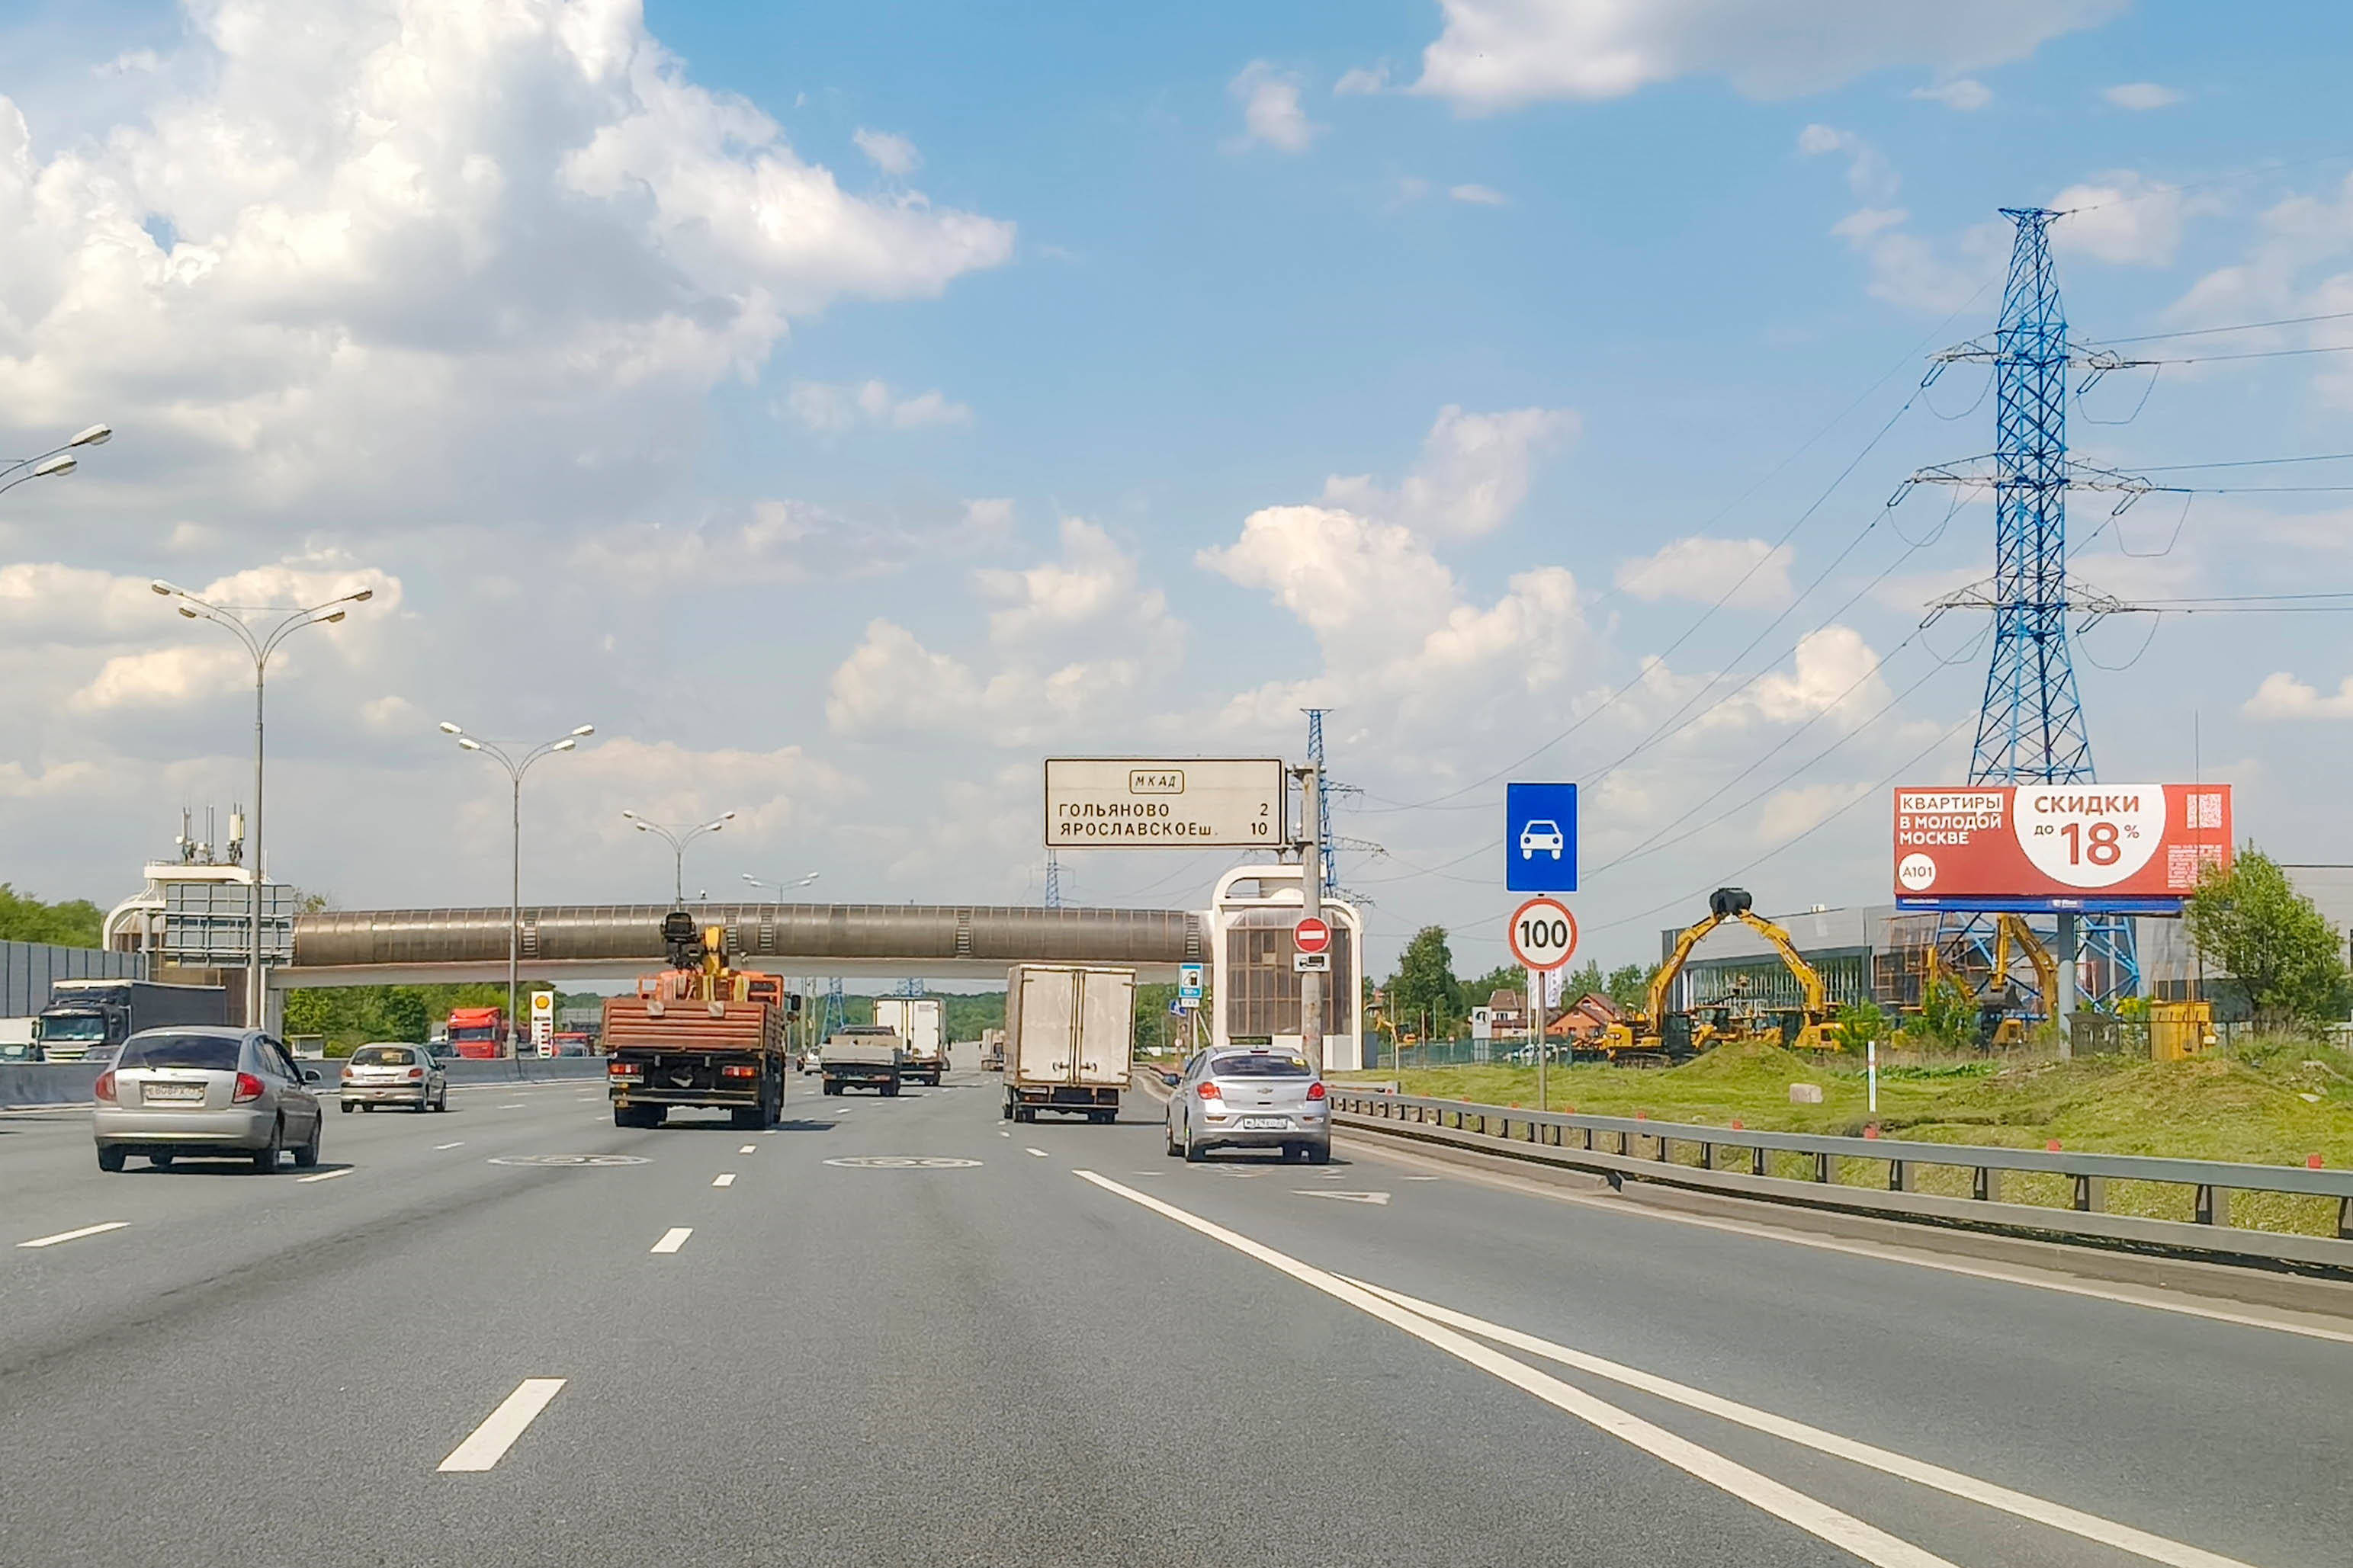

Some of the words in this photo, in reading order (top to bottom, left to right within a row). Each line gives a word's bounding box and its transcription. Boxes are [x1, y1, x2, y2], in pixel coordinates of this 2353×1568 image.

[1135, 775, 1176, 787] МКАД
[1059, 803, 1170, 817] ГОЛЬЯНОВО
[1260, 803, 1269, 816] 2
[1903, 797, 2000, 810] КВАРТИРЫ
[2034, 795, 2140, 816] СКИДКИ
[1250, 822, 1268, 835] 10
[1899, 816, 1911, 829] В
[1915, 813, 2001, 831] МОЛОДОЙ
[1899, 831, 1970, 845] МОСКВЕ
[1902, 866, 1932, 877] А101
[1520, 919, 1568, 948] 100
